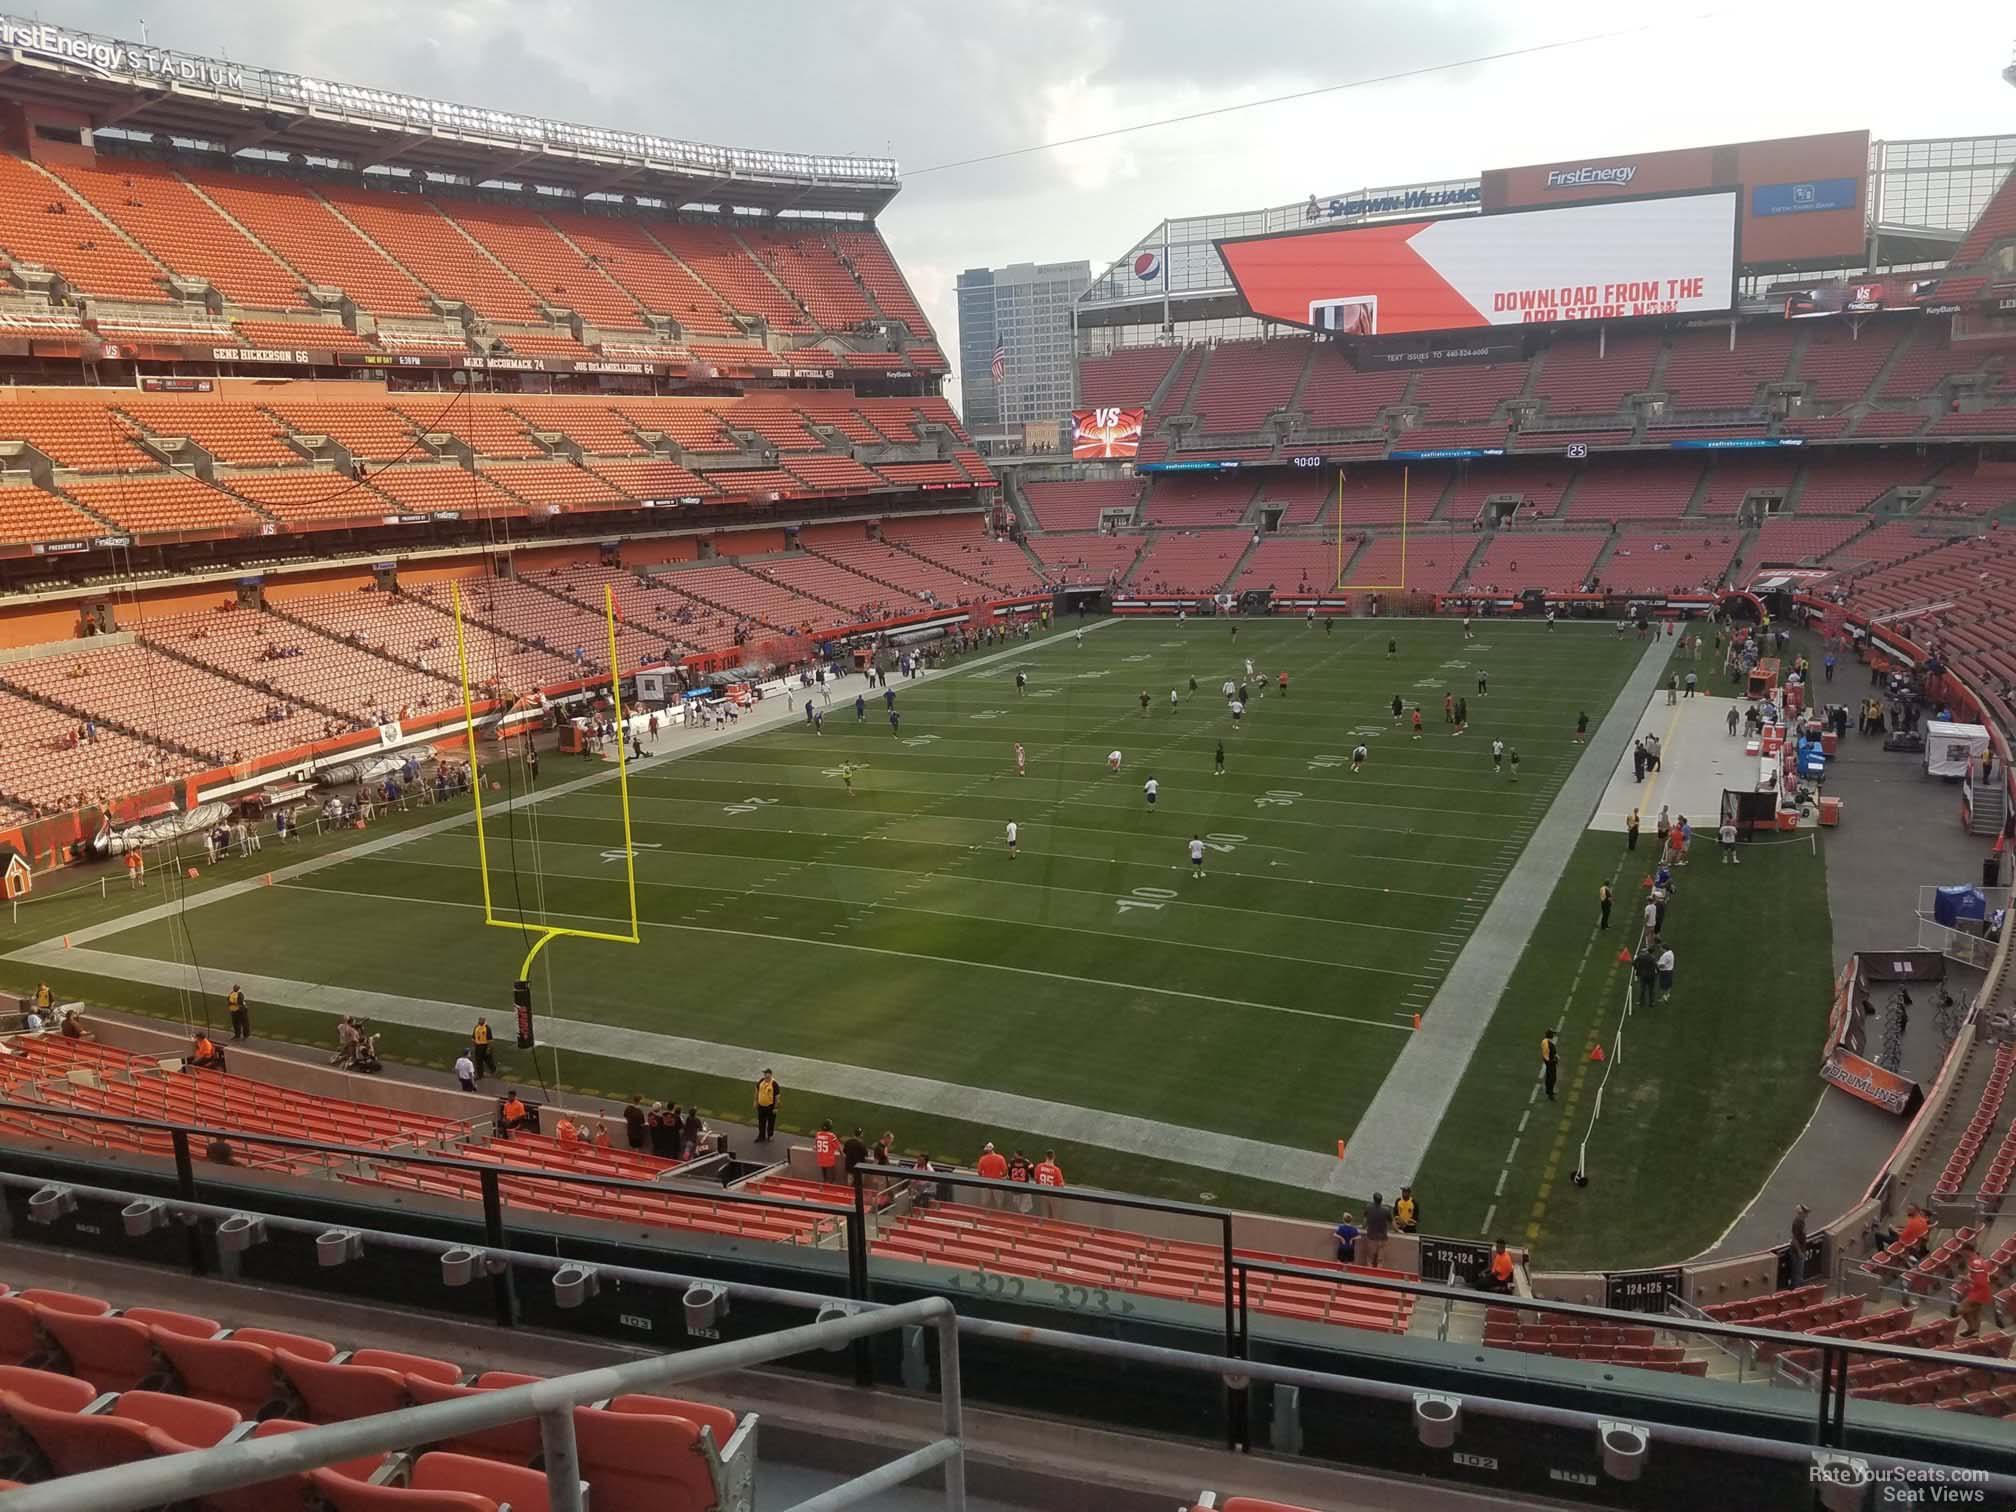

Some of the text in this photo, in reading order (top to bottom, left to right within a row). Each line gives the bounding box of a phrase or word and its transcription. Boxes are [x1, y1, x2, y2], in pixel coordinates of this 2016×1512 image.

[128, 50, 243, 89] STADIUM
[1547, 165, 1638, 186] FirstEnergy
[1494, 278, 1704, 312] DOWNLOAD FROM THE
[105, 345, 118, 356] VS
[213, 348, 308, 363] GENE HICKERSON 66
[463, 357, 484, 367] MIKE
[534, 359, 544, 371] 74
[886, 371, 912, 379] KeyBank
[1096, 408, 1120, 428] VS
[1570, 444, 1584, 456] 25
[1294, 457, 1320, 467] 90:00
[262, 524, 275, 535] VS
[723, 796, 780, 813] 20
[1253, 789, 1304, 806] 30
[1115, 887, 1179, 911] 10
[1829, 1064, 1900, 1106] DRUMLINE
[816, 1140, 829, 1153] 95
[1040, 1174, 1055, 1186] 95
